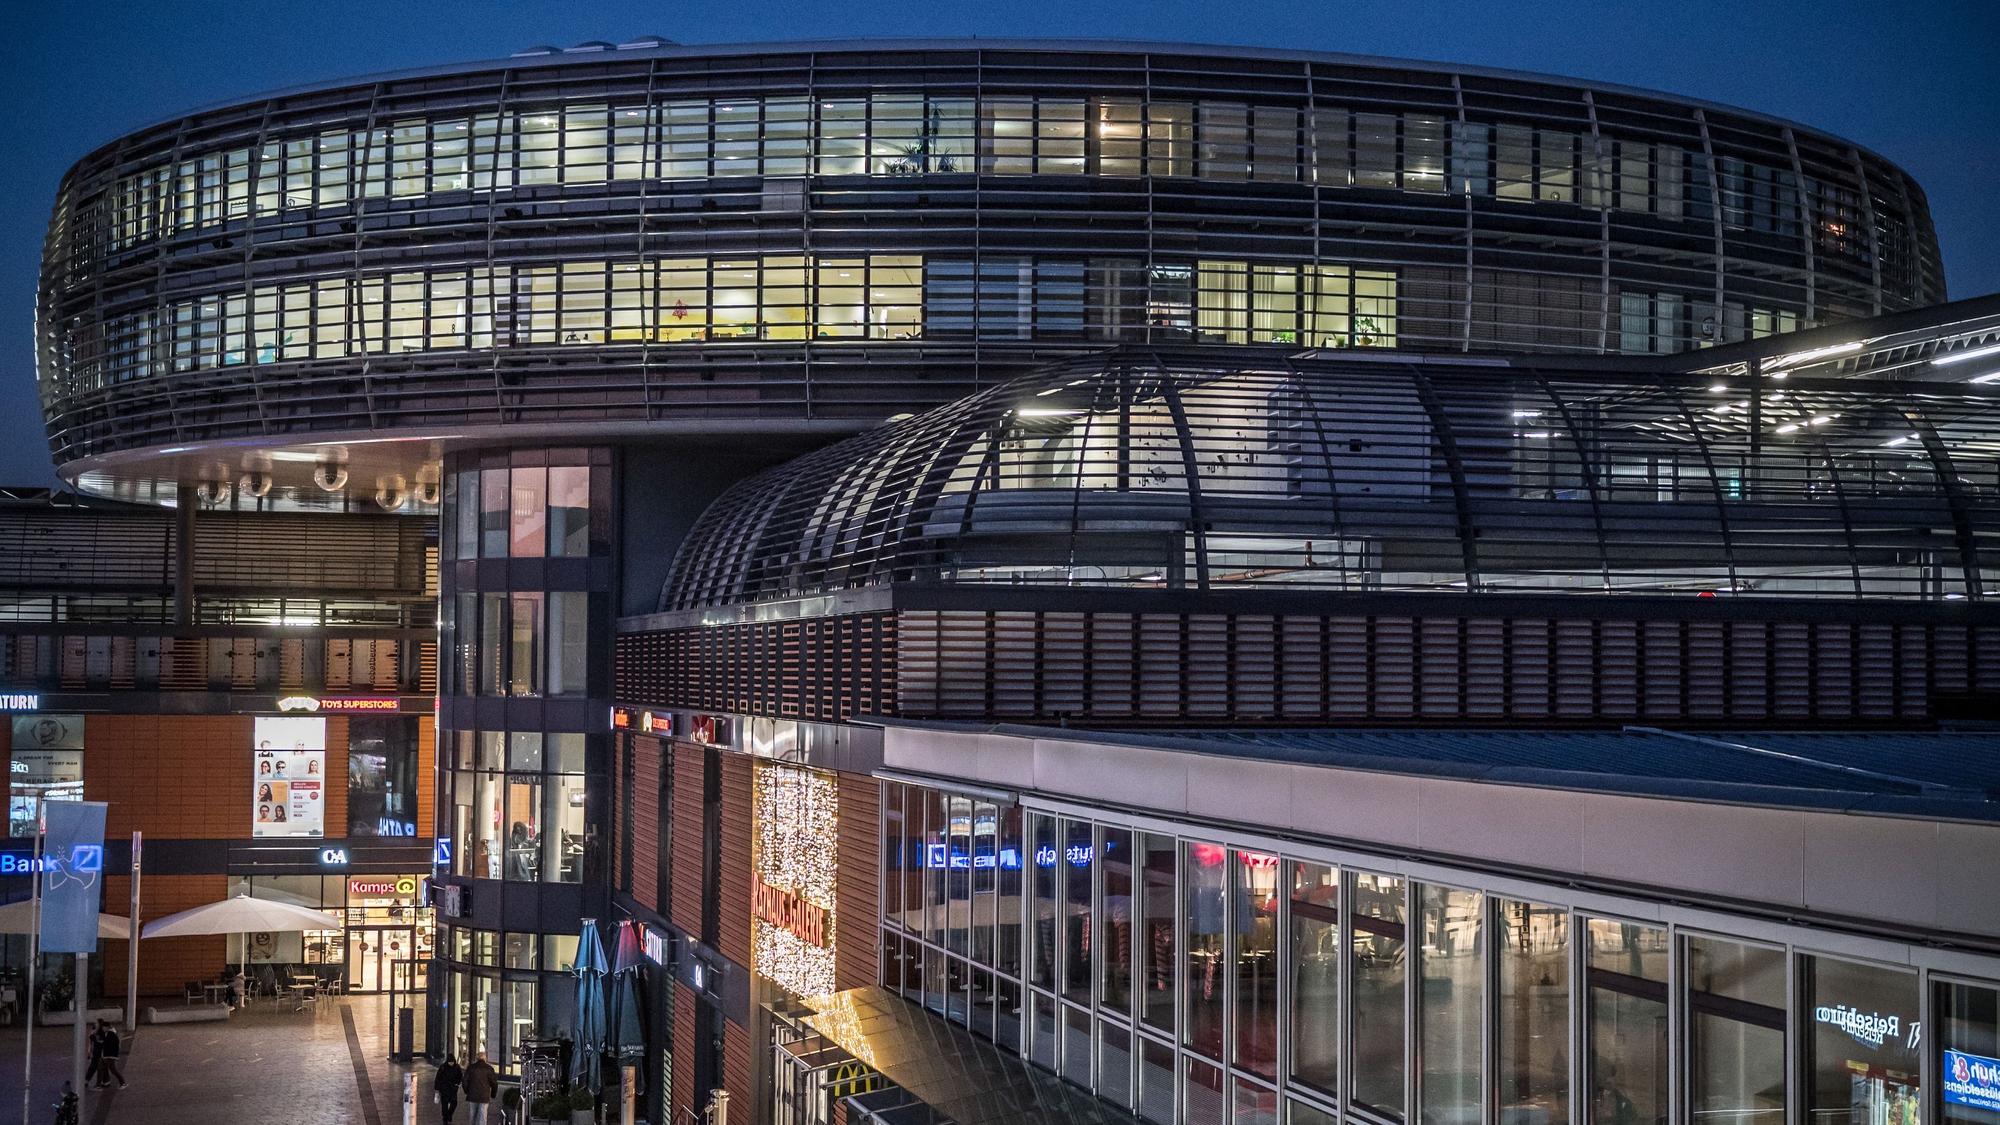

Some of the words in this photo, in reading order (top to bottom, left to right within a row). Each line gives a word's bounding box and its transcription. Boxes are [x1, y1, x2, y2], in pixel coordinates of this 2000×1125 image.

[322, 700, 342, 708] TOYS
[344, 700, 397, 709] SUPERSTORES
[1, 854, 58, 872] Bank
[351, 881, 396, 894] Kamps
